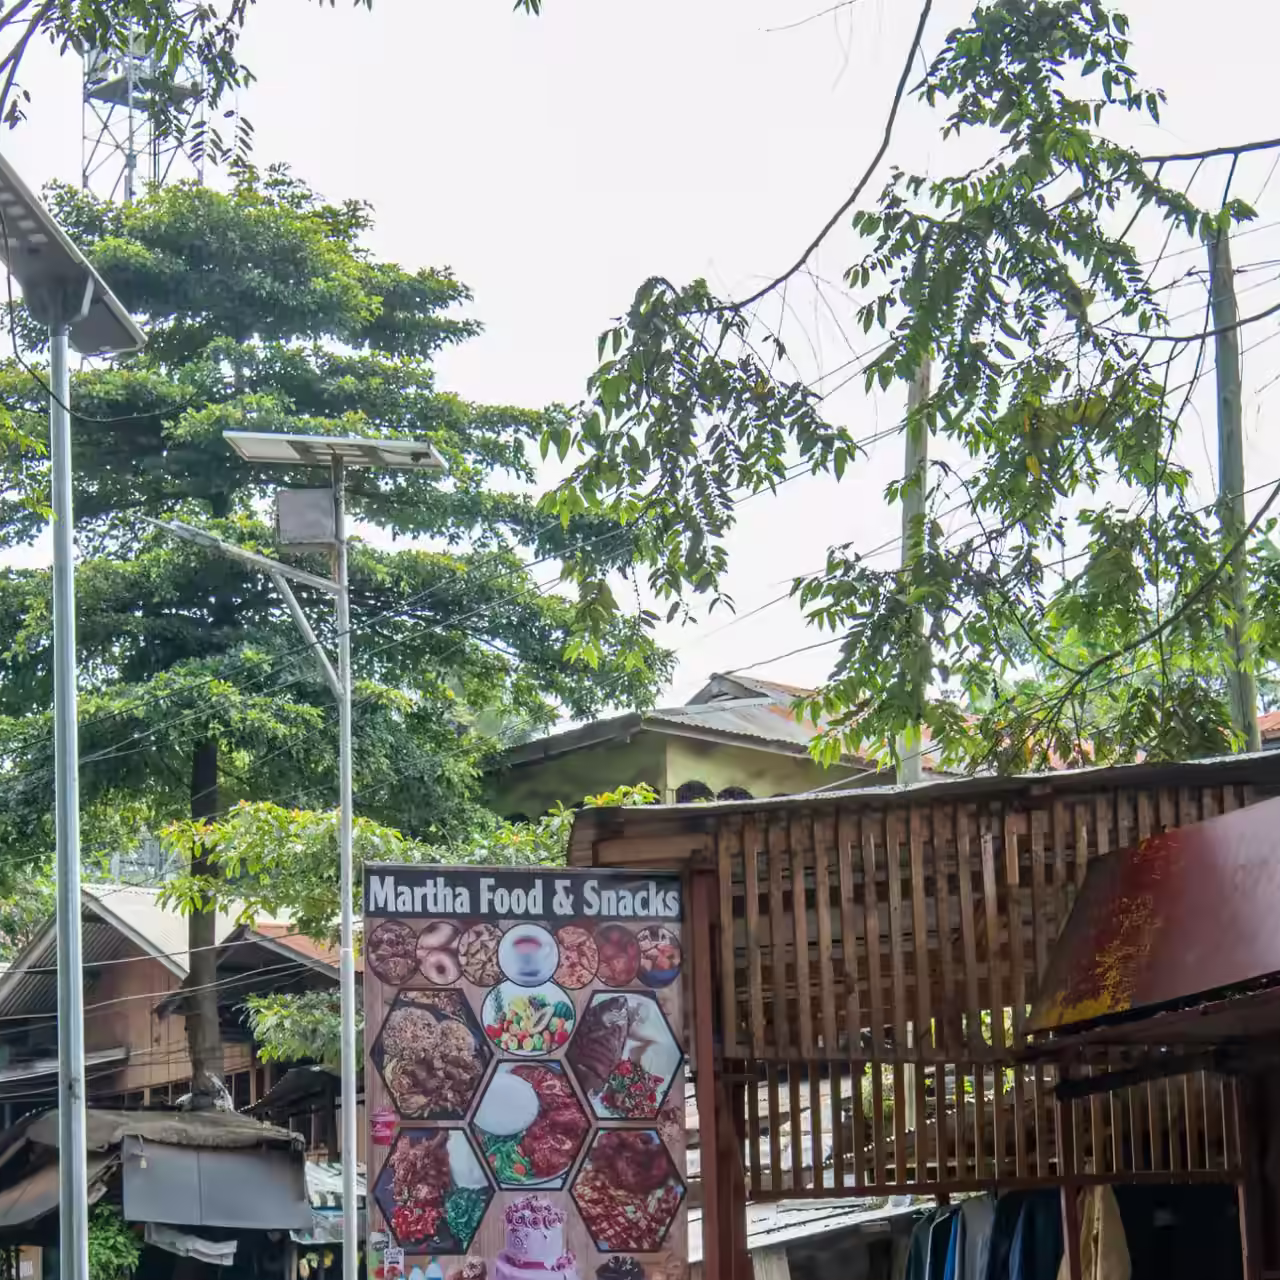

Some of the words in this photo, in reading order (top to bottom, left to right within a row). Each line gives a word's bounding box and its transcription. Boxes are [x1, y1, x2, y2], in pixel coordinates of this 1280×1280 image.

[369, 875, 470, 913] Martha
[479, 877, 543, 915] Food
[553, 879, 574, 916] &
[583, 879, 680, 917] Snacks
